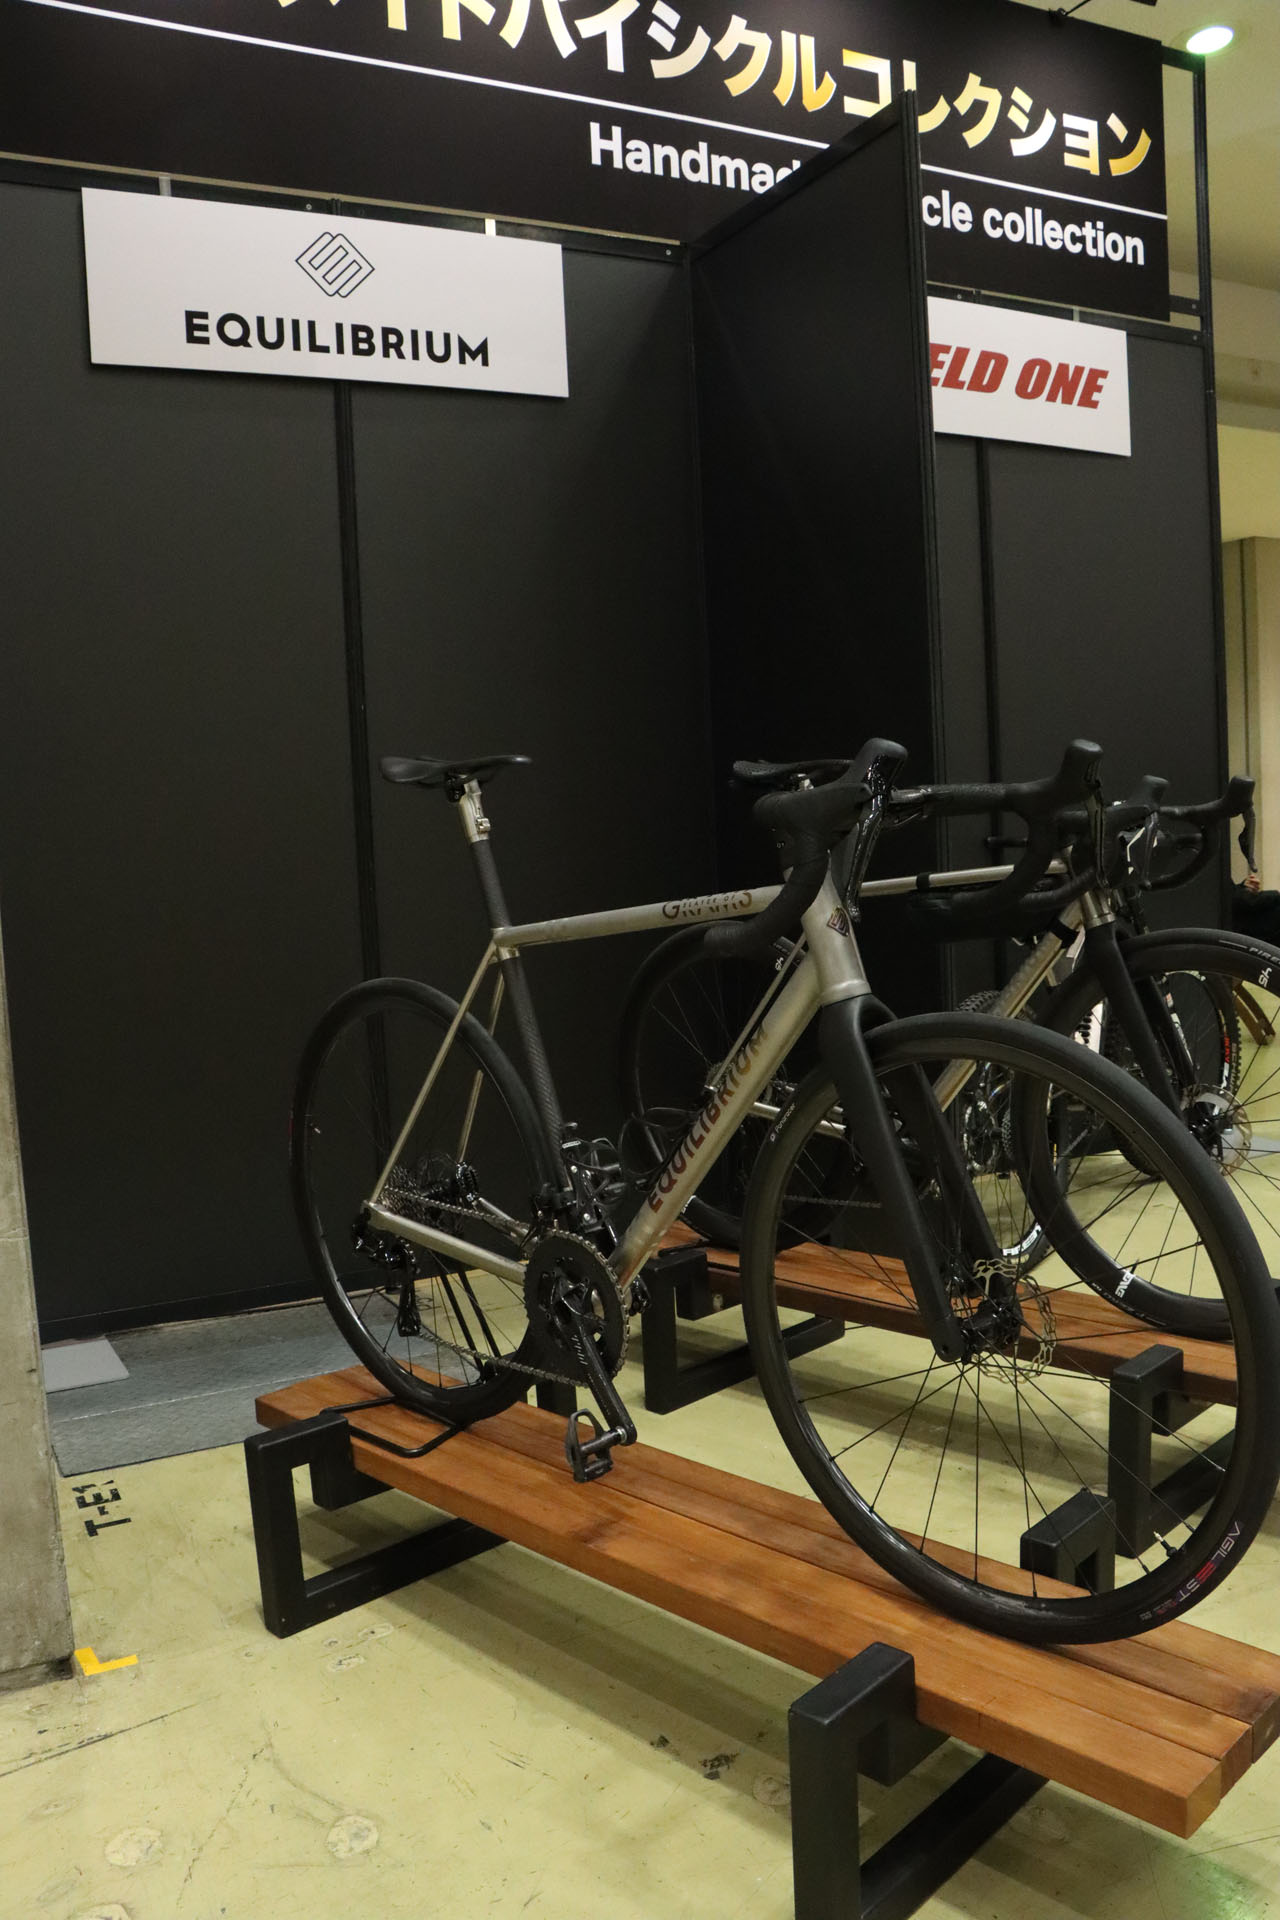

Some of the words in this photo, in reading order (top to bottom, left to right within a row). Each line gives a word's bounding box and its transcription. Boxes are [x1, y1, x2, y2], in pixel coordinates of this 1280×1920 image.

[278, 0, 1152, 176] バイシクルコレクション
[982, 206, 1145, 266] collection
[184, 309, 490, 367] EQUILIBRIUM
[929, 342, 1009, 394] ELD
[1014, 358, 1109, 410] ONE
[1178, 1521, 1241, 1602] AGILEST
